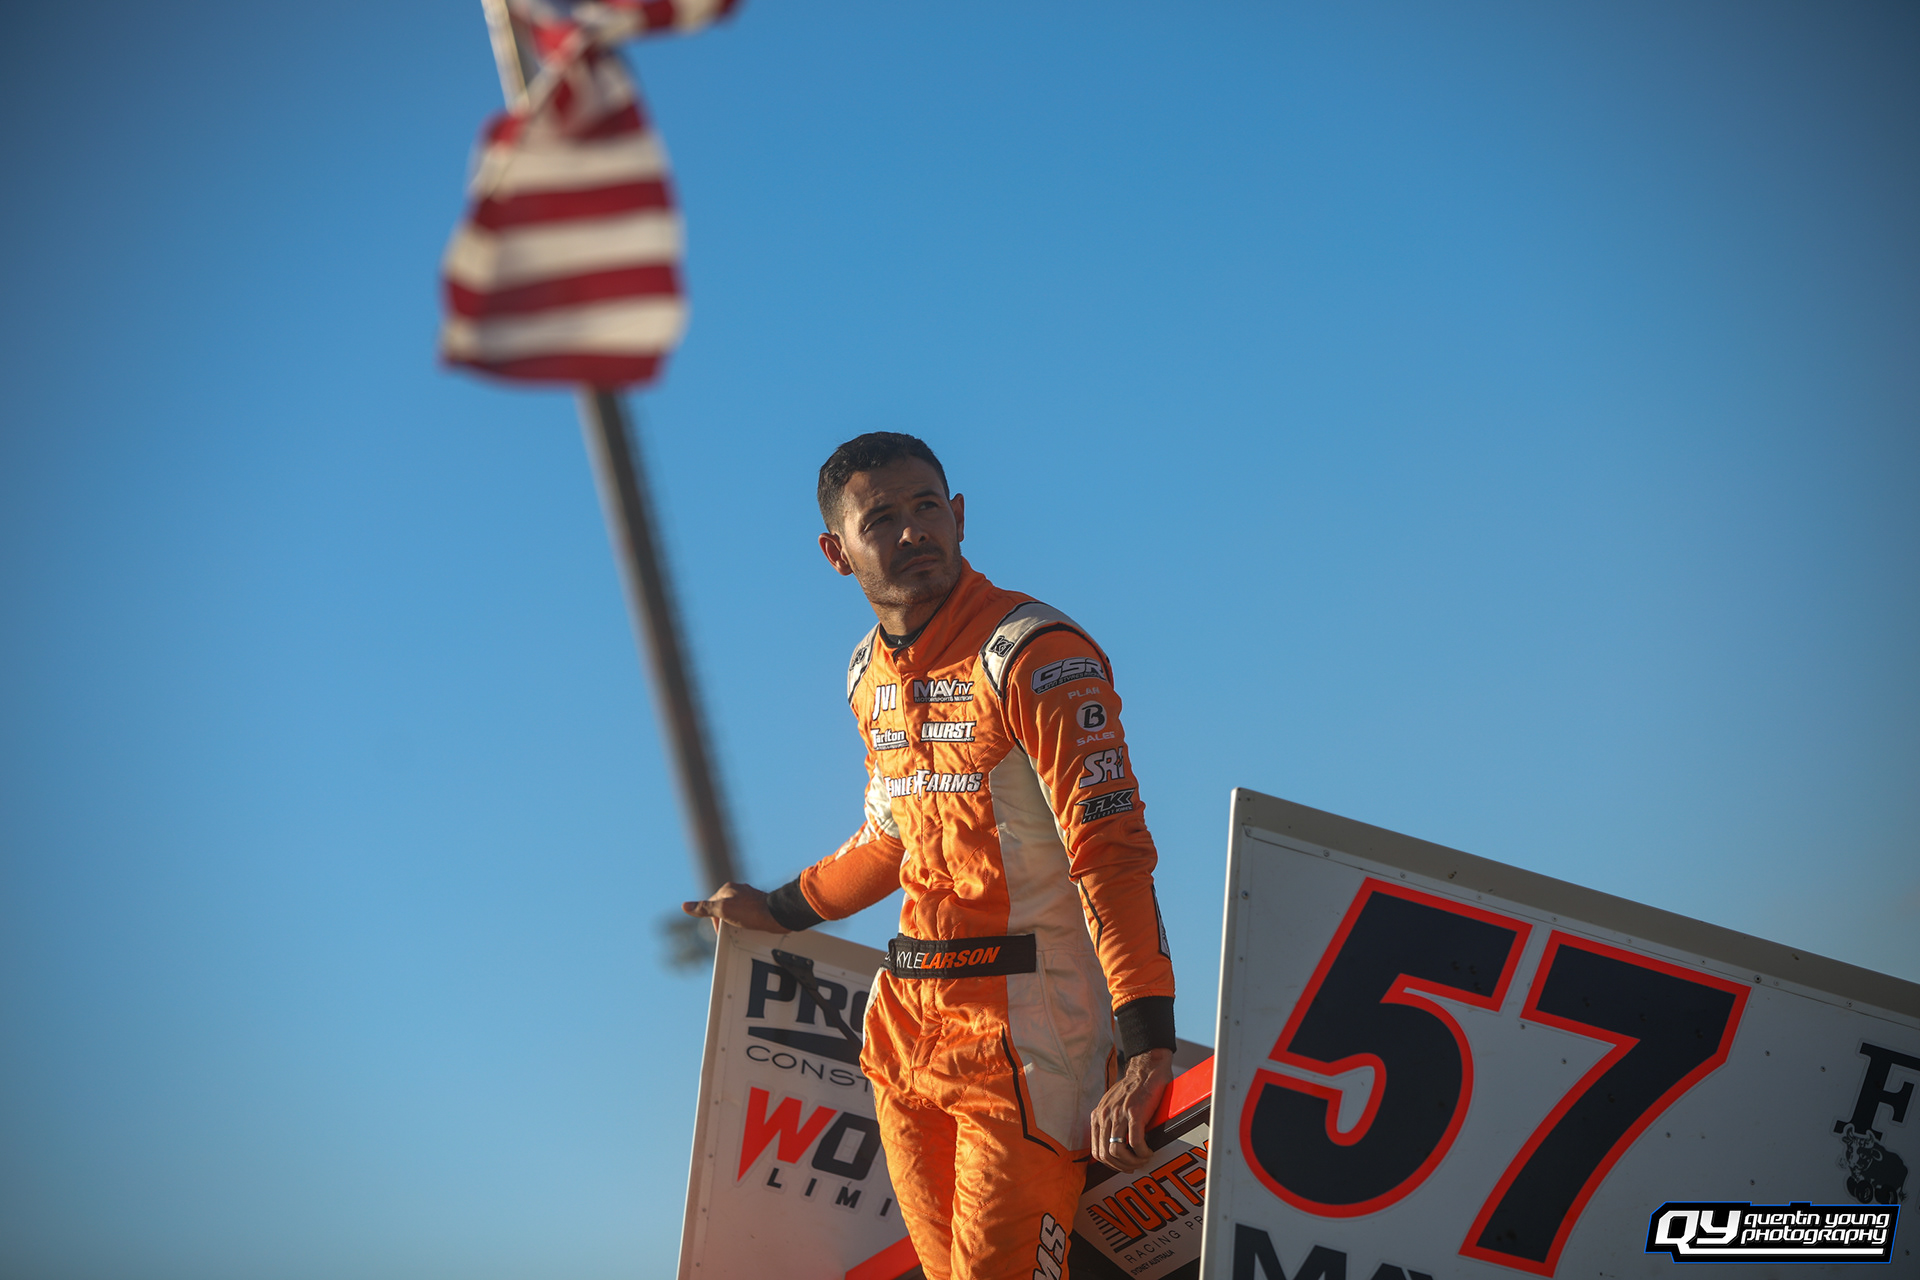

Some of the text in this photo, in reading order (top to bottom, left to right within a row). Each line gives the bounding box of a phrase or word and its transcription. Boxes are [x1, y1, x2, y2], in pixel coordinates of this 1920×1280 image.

[1032, 656, 1105, 689] GSR
[872, 684, 897, 721] JVI
[1082, 704, 1105, 728] B
[871, 729, 906, 749] Tarlton
[921, 721, 976, 740] DURST
[1076, 731, 1115, 746] SALES
[1240, 876, 1752, 1278] 57
[766, 1167, 892, 1217] LIMI
[1124, 1229, 1181, 1263] RACING
